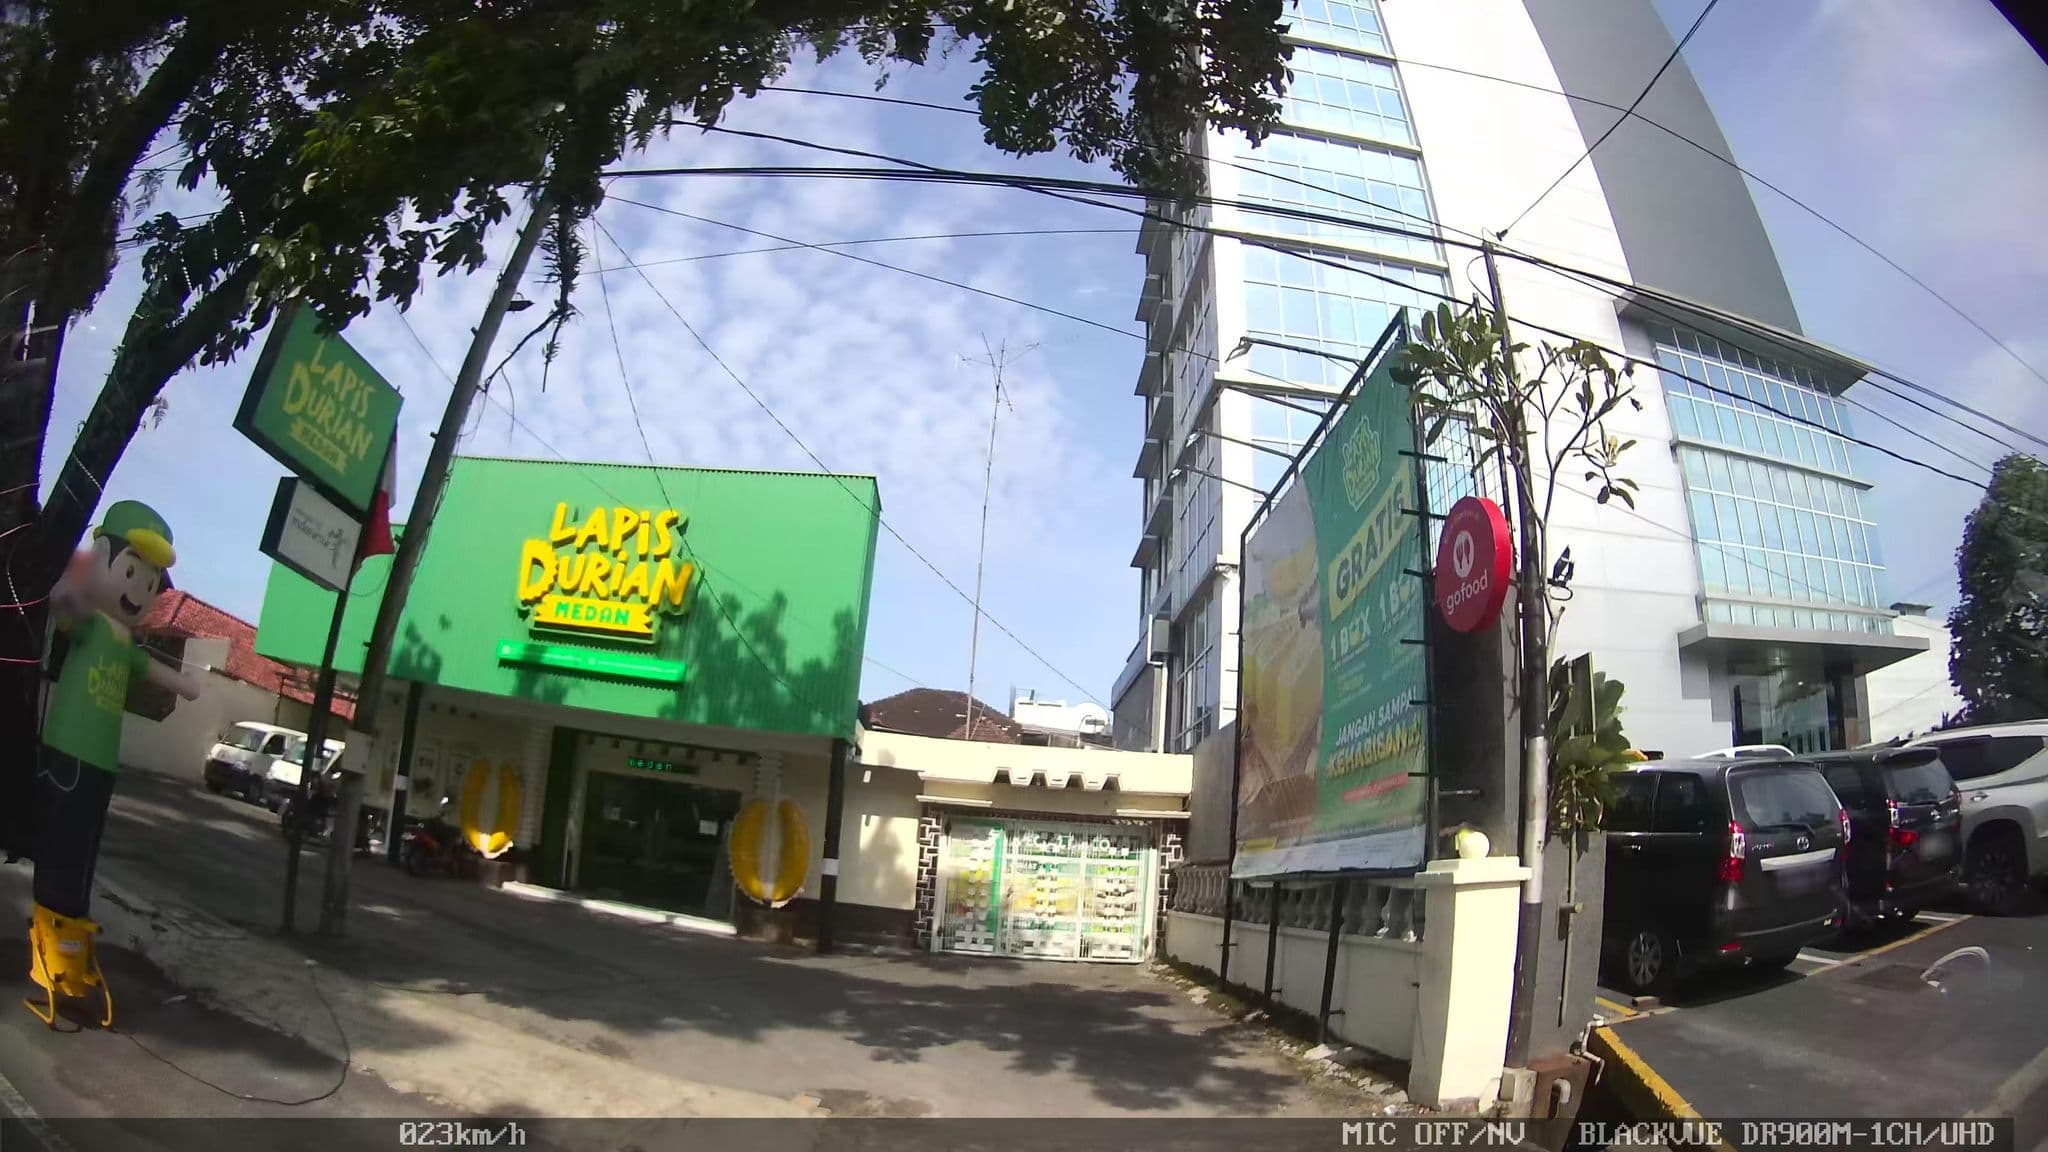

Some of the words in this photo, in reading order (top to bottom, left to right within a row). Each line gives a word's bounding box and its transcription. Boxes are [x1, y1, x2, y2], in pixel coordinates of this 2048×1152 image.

[1336, 480, 1403, 601] GRATIS
[554, 601, 630, 626] MEDAN
[1446, 568, 1489, 616] gofood
[1335, 709, 1376, 747] JANGAN
